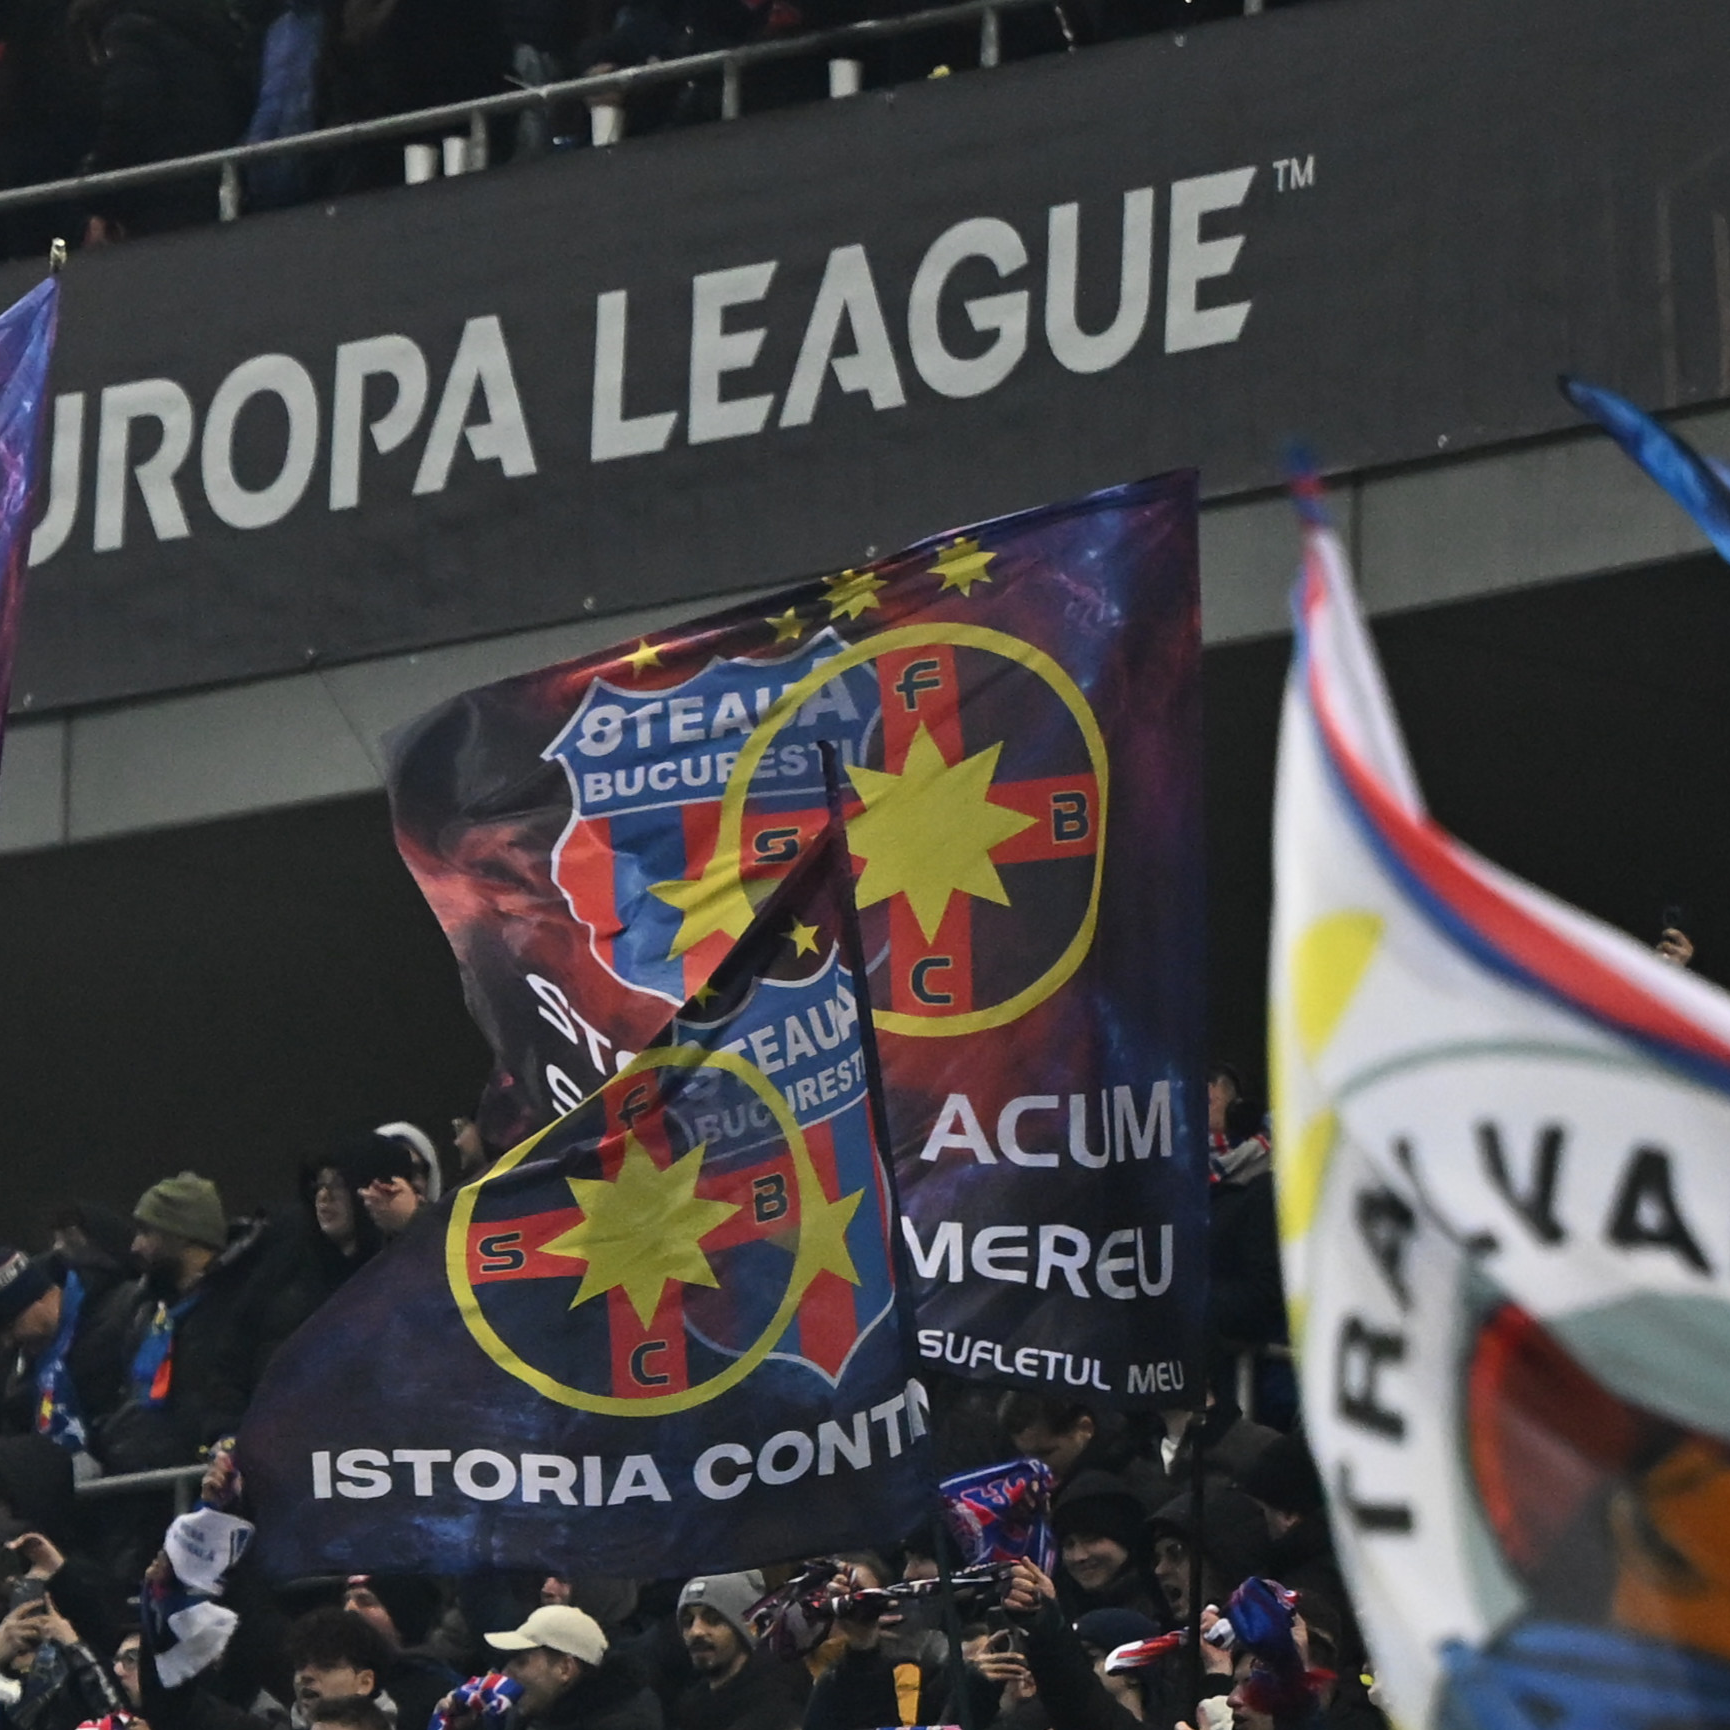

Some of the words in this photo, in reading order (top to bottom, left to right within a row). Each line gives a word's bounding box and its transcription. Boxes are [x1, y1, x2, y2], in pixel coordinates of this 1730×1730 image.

[591, 166, 1255, 463] LEAGUE
[895, 658, 943, 712] F
[1051, 790, 1091, 844] B
[911, 957, 954, 1003] C
[919, 1080, 1173, 1169] ACUM
[752, 1173, 788, 1224] B
[901, 1215, 1175, 1301] MEREU
[629, 1339, 669, 1387] C
[917, 1329, 1112, 1392] SUFLETUL
[1126, 1360, 1185, 1395] MEU
[311, 1447, 674, 1508] ISTORIA
